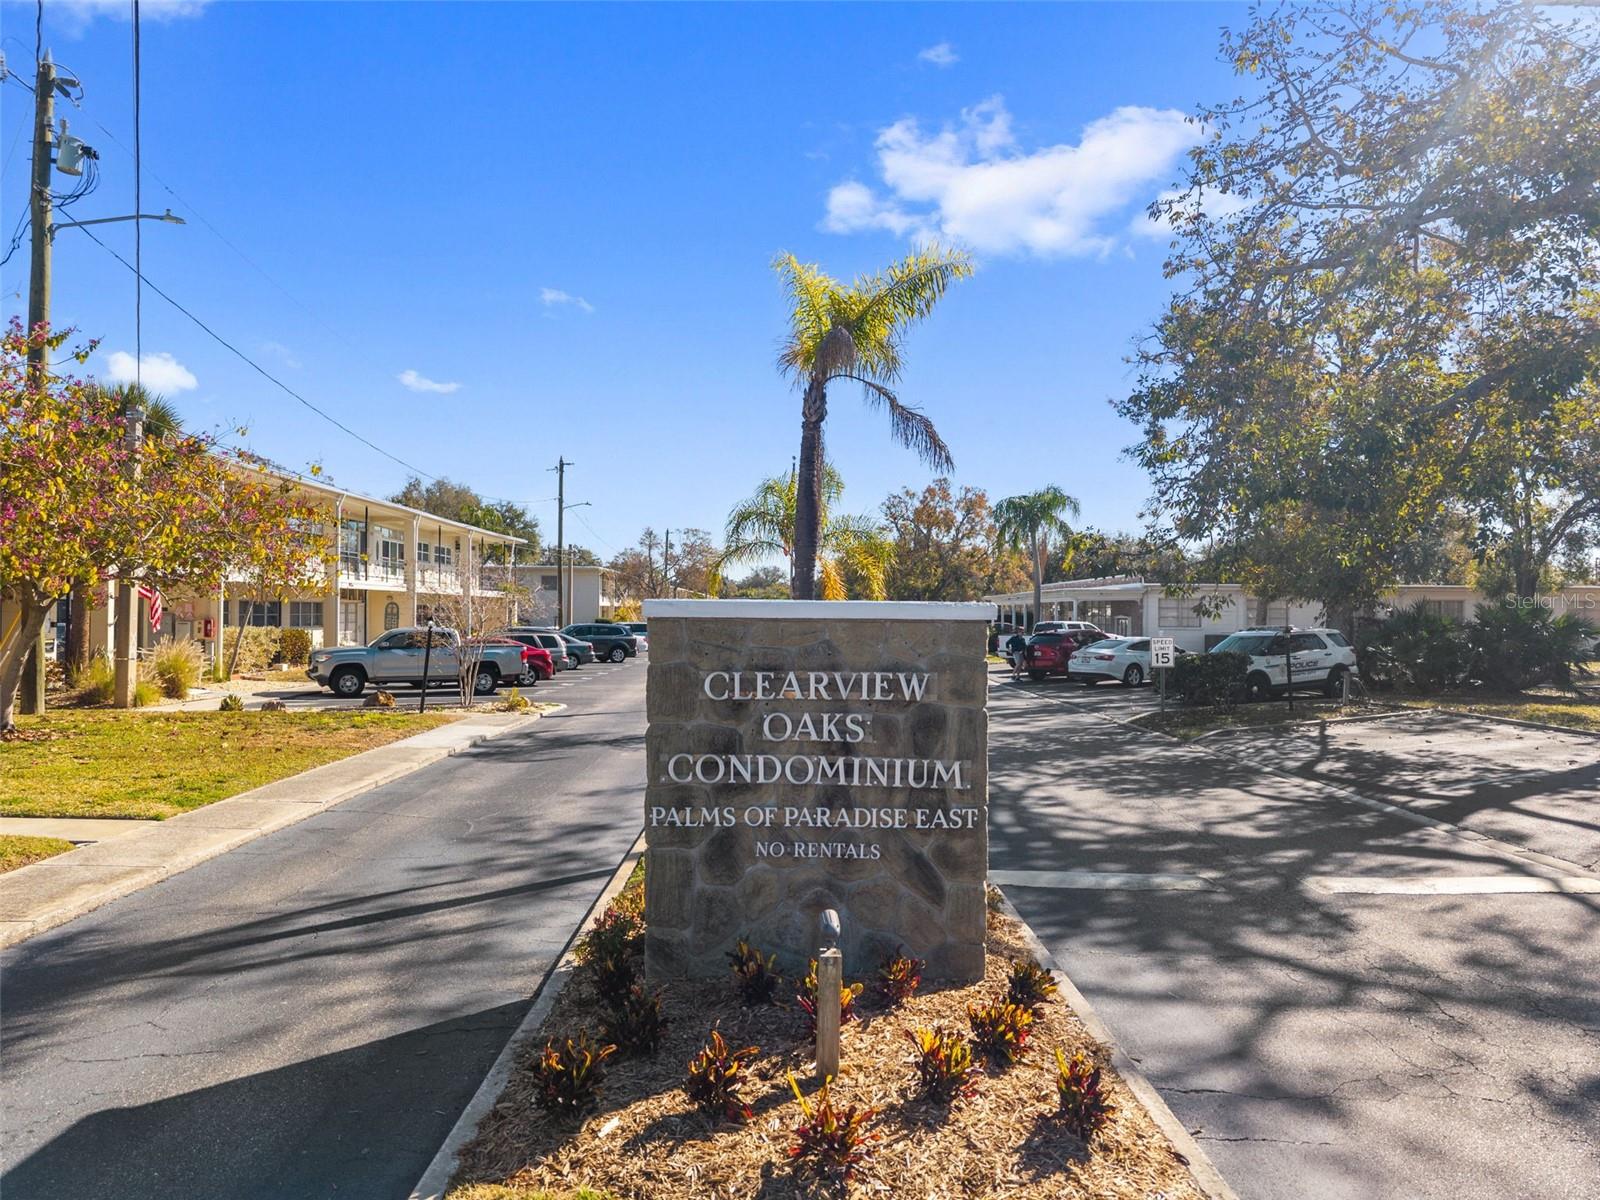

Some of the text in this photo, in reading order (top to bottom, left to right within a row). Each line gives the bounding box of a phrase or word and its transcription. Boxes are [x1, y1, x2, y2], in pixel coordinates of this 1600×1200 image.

[1155, 652, 1170, 664] 15
[704, 671, 929, 701] CLEARVIEW
[763, 712, 865, 743] OAKS
[651, 806, 978, 829] PALMS OF PARADISE EAST
[755, 841, 881, 860] NO RENTALS
